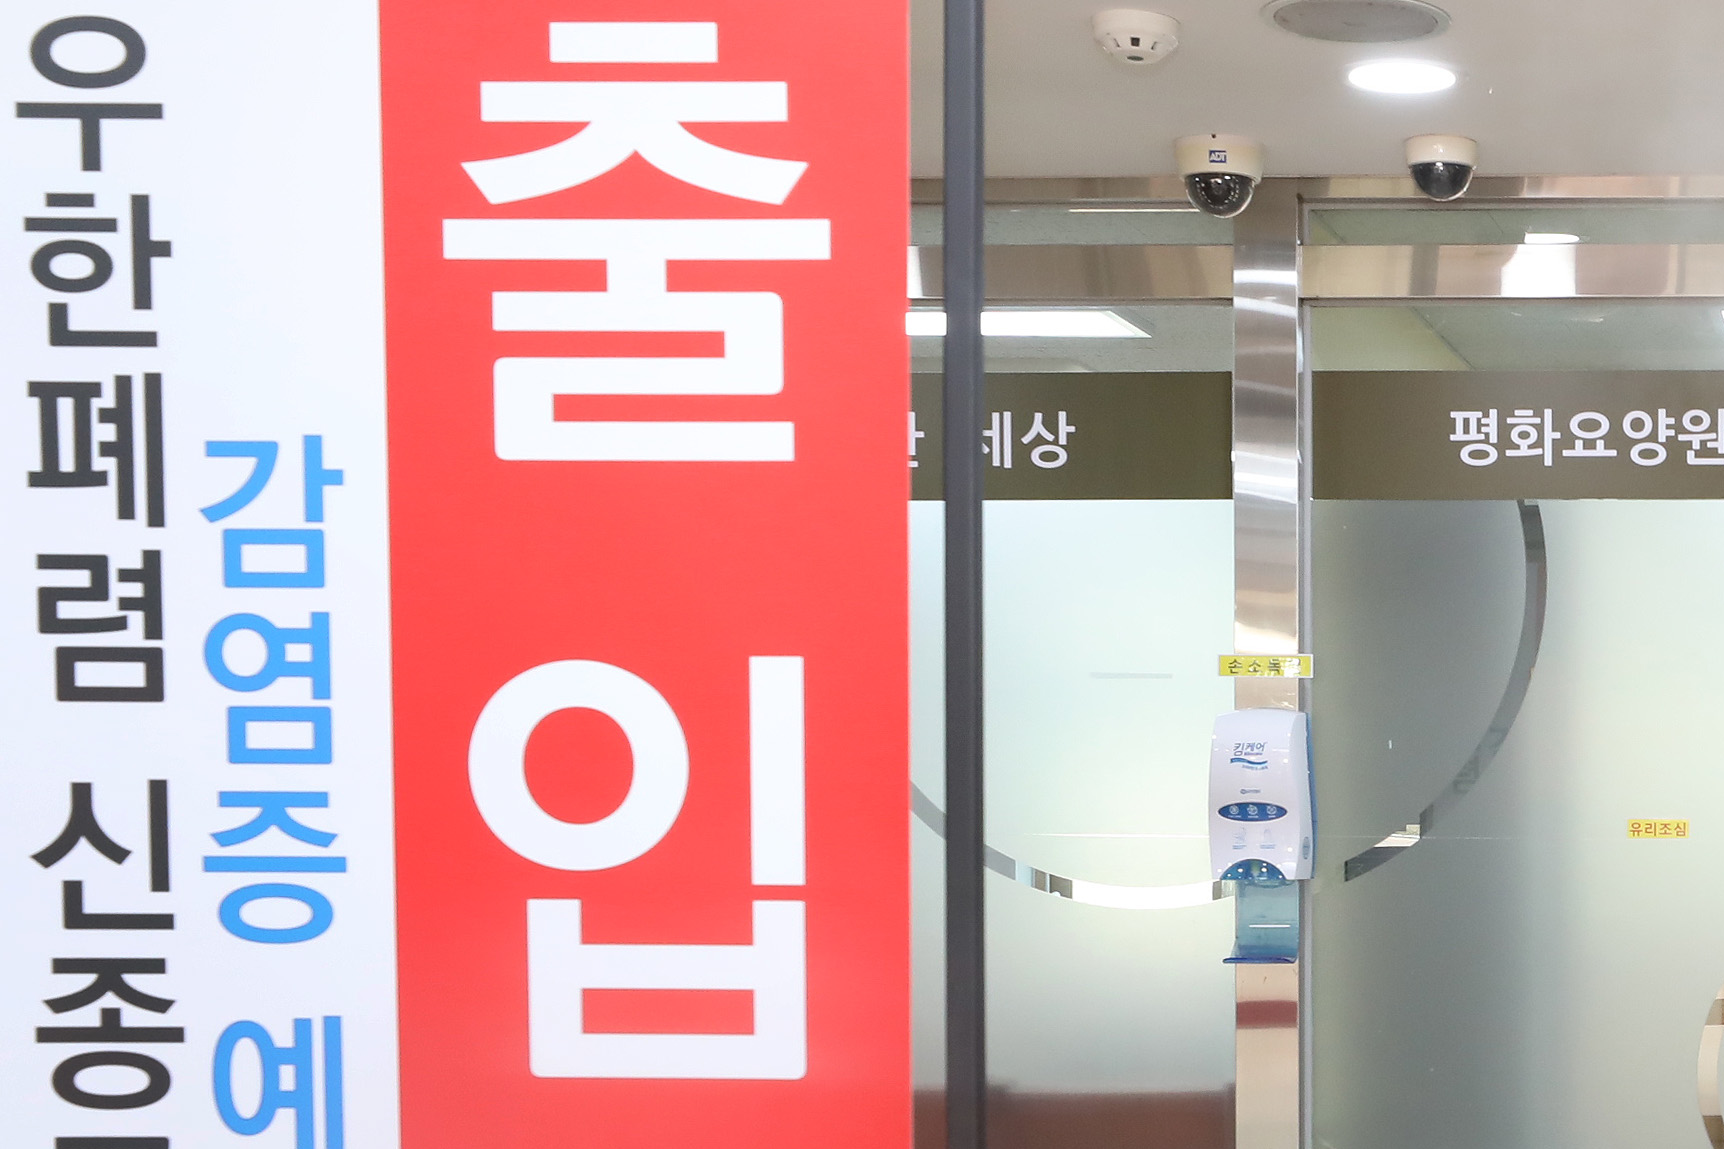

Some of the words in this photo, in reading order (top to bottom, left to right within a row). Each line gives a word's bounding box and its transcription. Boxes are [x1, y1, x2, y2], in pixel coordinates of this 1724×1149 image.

[1210, 152, 1226, 161] ADT
[15, 15, 172, 703] 우한폐렴
[1228, 658, 1301, 675] 손소독
[199, 434, 348, 945] 감염증
[1629, 822, 1687, 837] 유리조심
